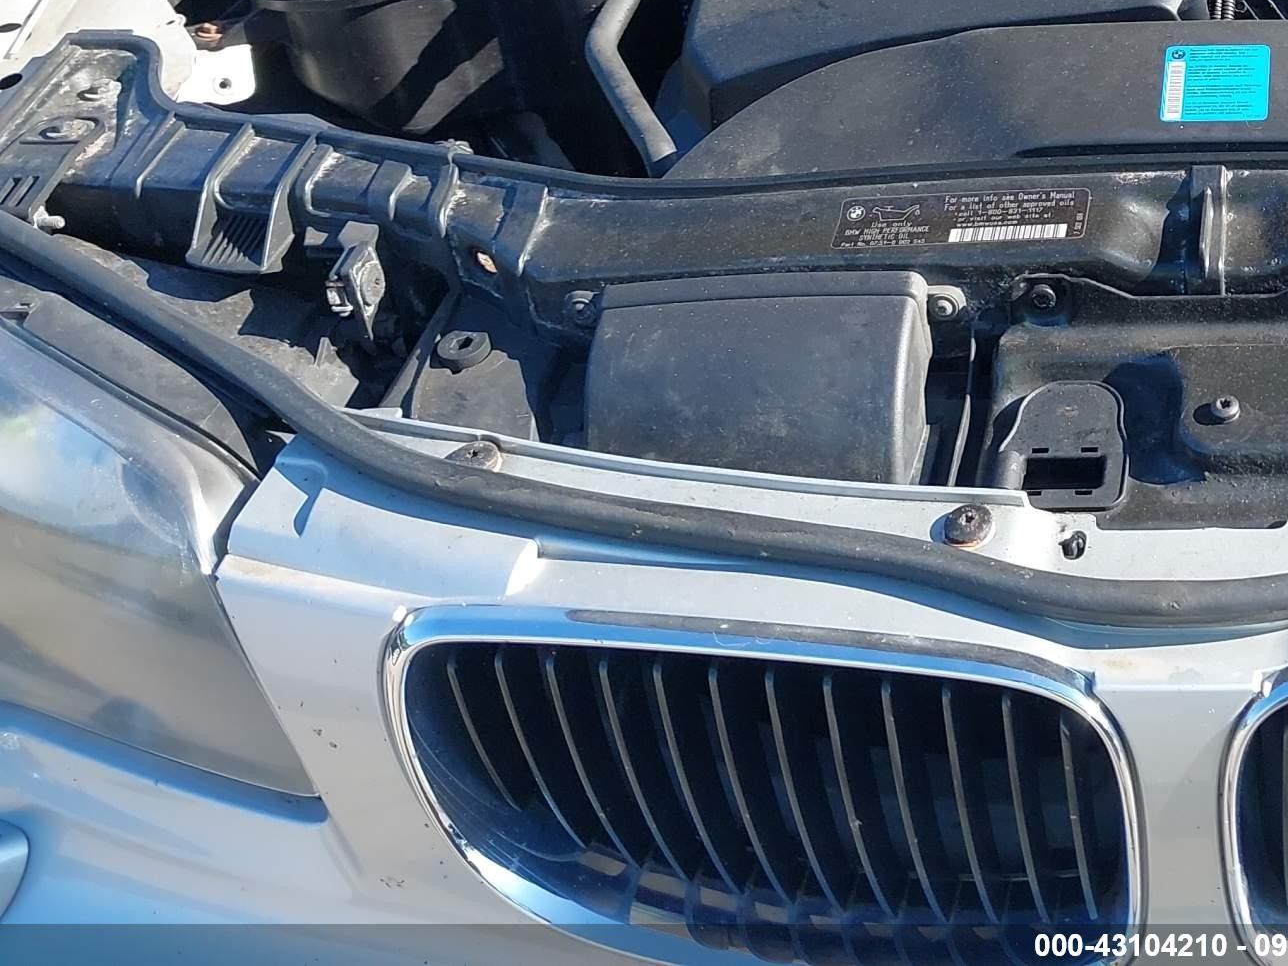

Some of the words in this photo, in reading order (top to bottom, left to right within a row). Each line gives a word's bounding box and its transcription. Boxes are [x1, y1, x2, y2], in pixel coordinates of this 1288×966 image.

[945, 196, 958, 204] For
[984, 194, 998, 202] info
[1018, 192, 1047, 200] Owner's
[1050, 191, 1075, 199] Manual
[944, 204, 957, 212] For
[1023, 200, 1056, 208] approved
[883, 226, 930, 234] PERFORMANCE
